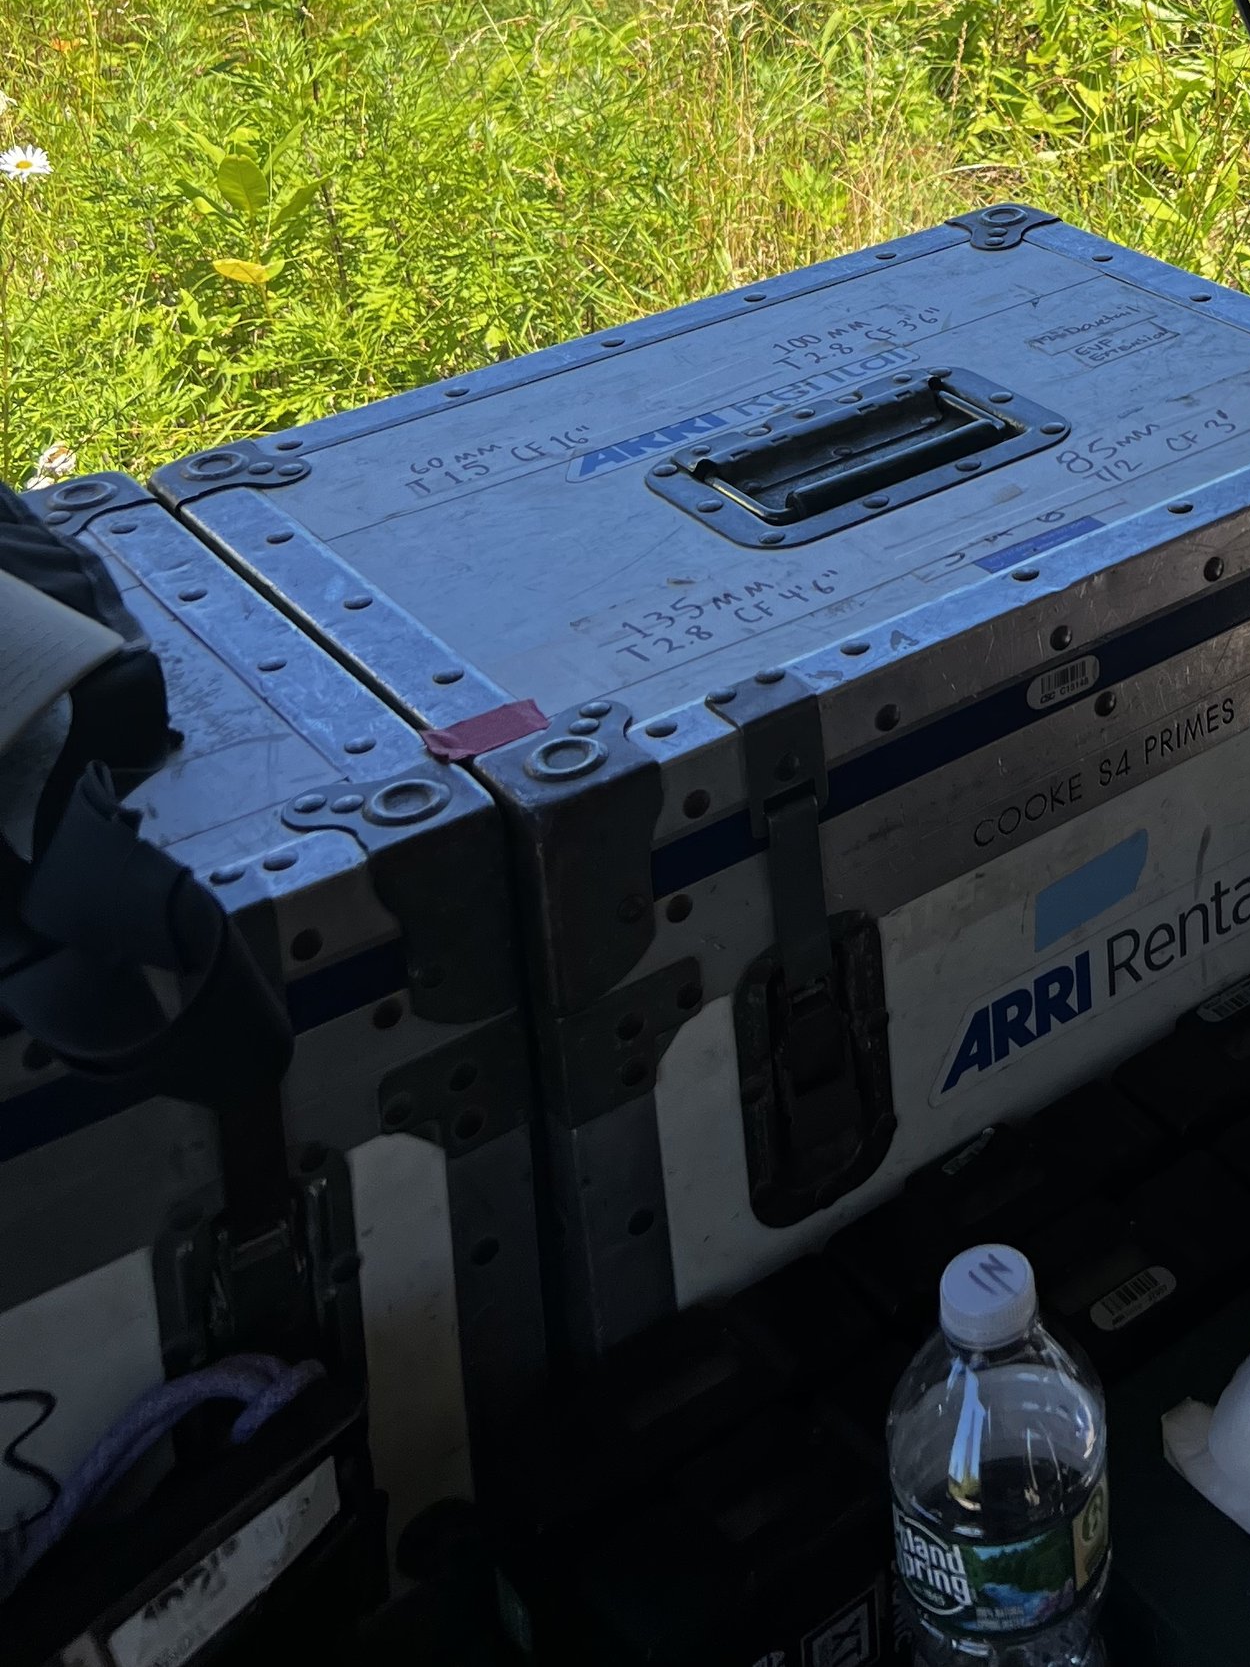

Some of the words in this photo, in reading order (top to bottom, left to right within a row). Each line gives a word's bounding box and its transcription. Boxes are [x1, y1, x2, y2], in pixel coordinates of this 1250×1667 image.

[772, 356, 803, 372] T
[804, 342, 854, 365] 2.8
[864, 325, 899, 342] CF
[773, 333, 823, 356] 100
[1074, 338, 1115, 357] EVF
[1165, 430, 1200, 452] CF
[404, 477, 432, 494] T
[444, 459, 491, 486] 1.5
[510, 440, 547, 463] CF
[410, 456, 445, 475] 60
[615, 643, 650, 663] T
[652, 624, 714, 654] 2.8
[734, 599, 774, 624] CF
[622, 596, 705, 639] 135
[973, 772, 1083, 848] COOKE
[1099, 748, 1132, 786] S4
[1144, 696, 1235, 766] PRIMES
[940, 948, 1093, 1094] ARRI
